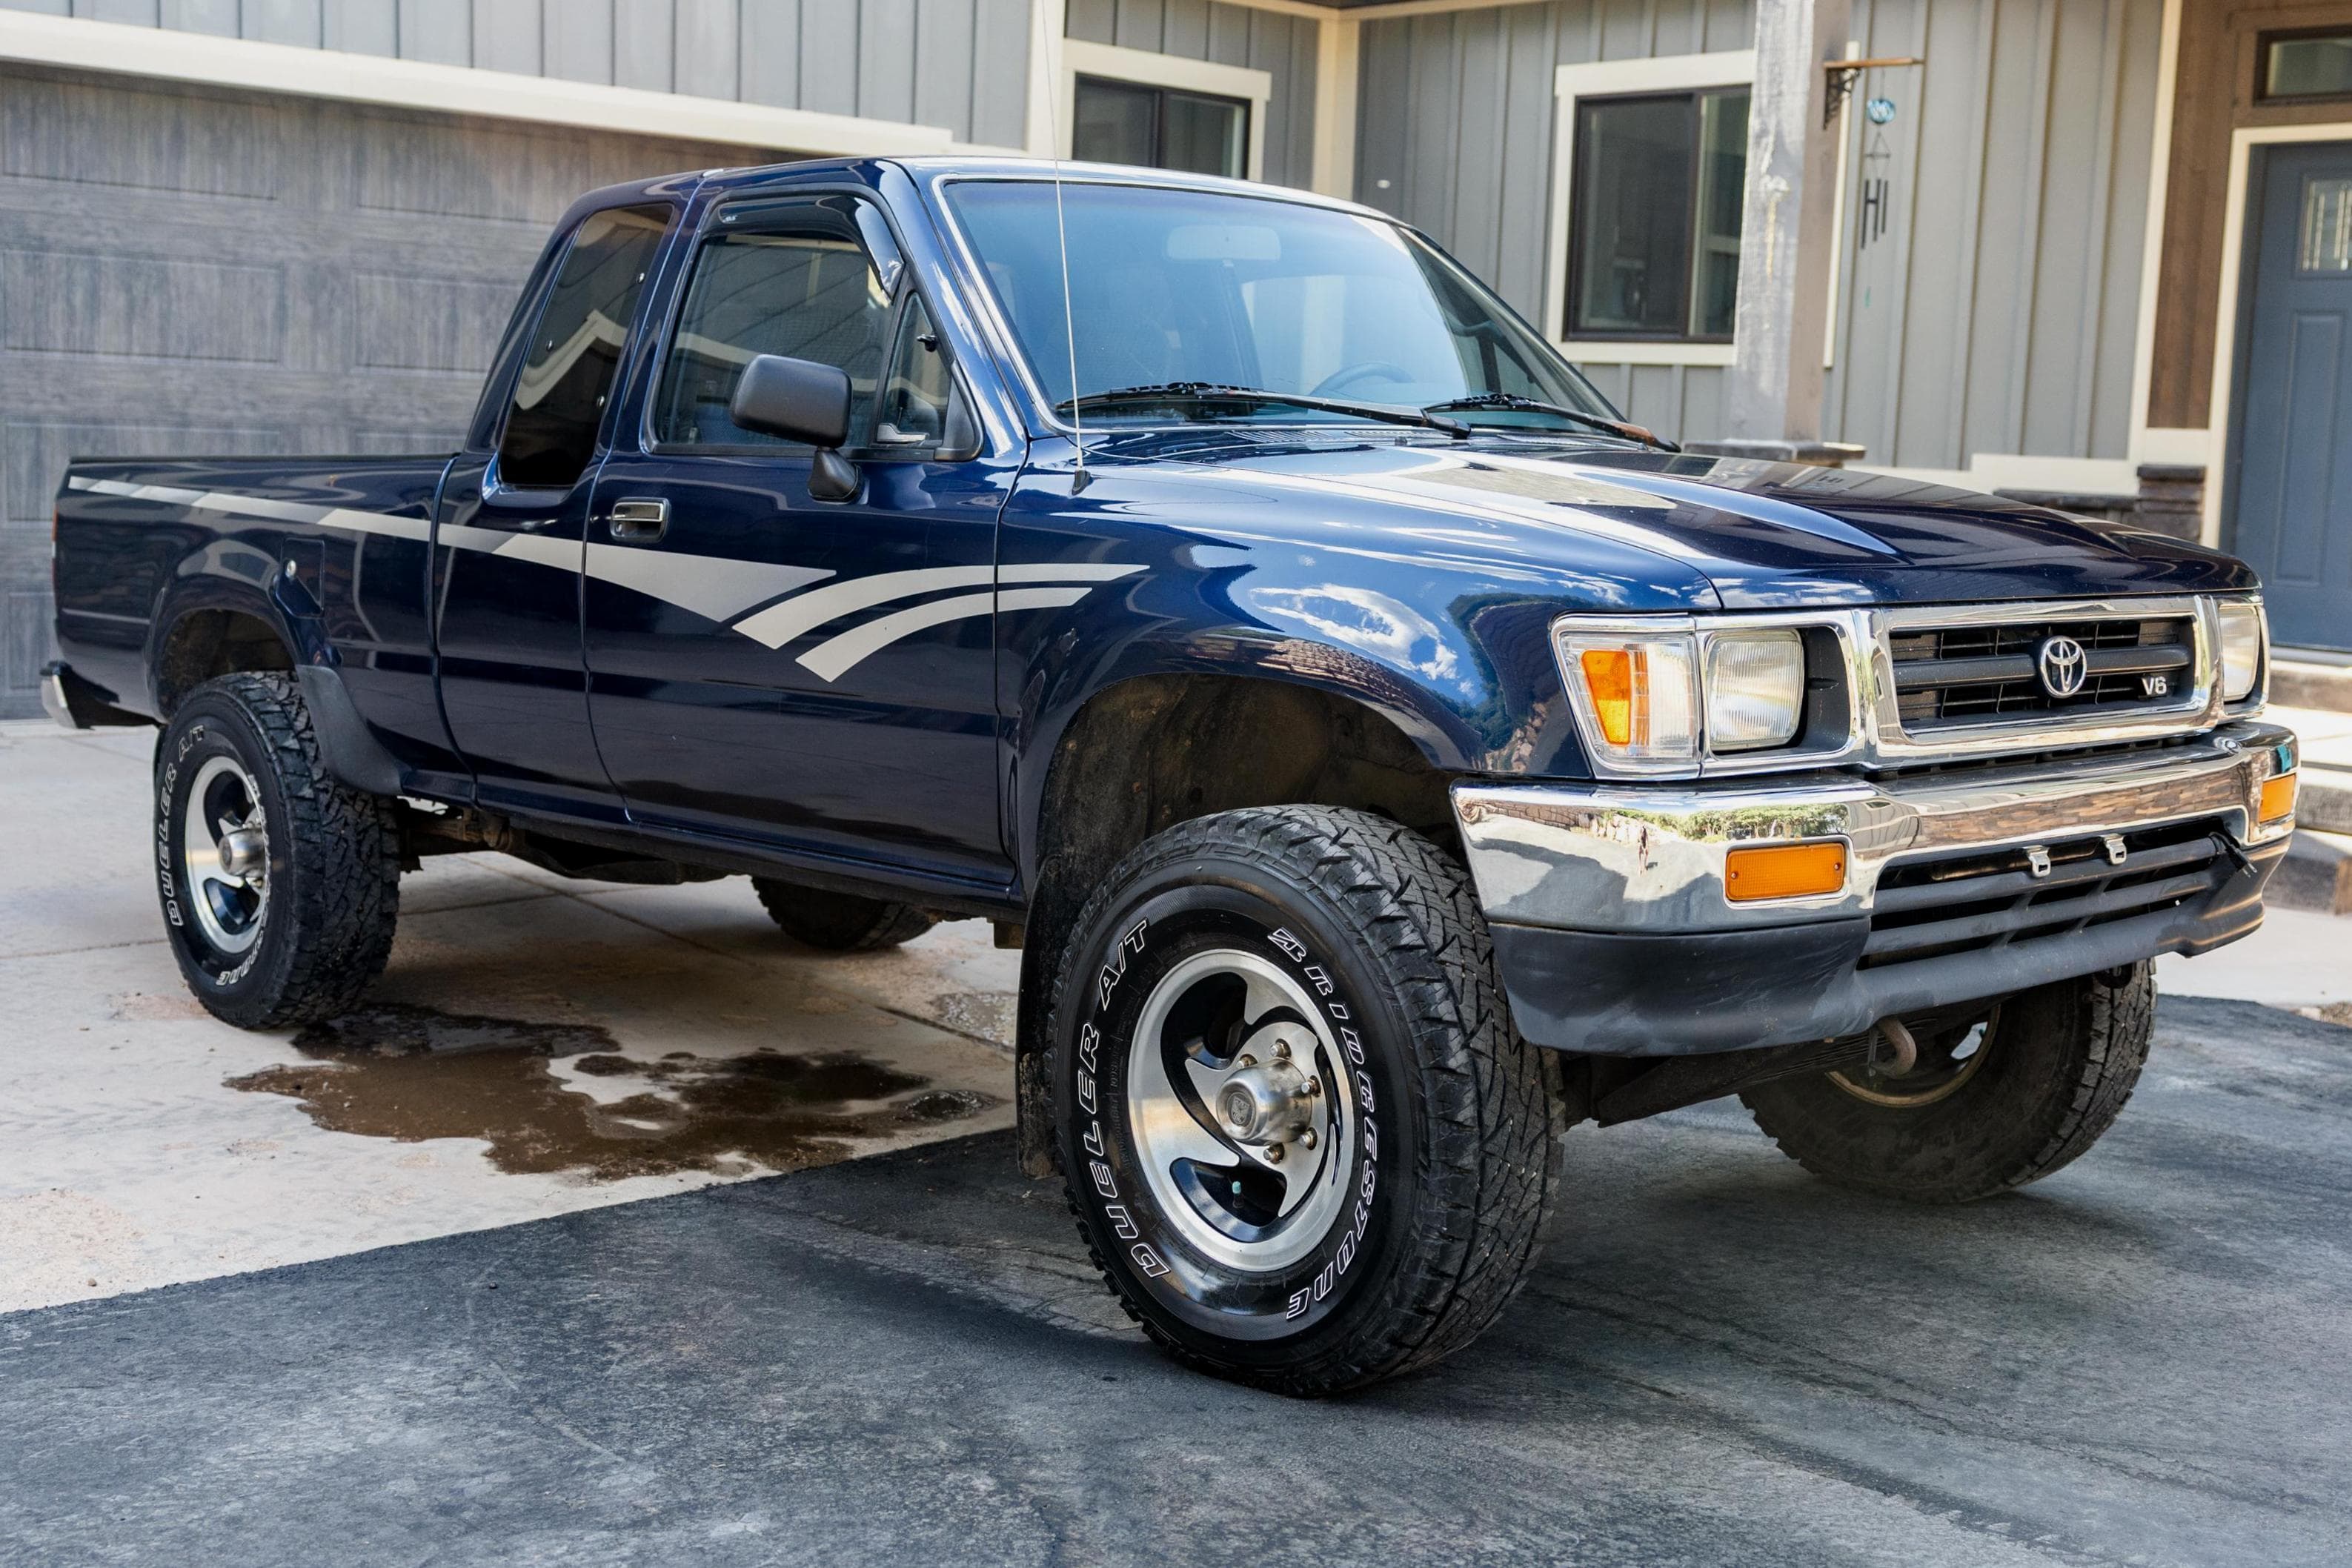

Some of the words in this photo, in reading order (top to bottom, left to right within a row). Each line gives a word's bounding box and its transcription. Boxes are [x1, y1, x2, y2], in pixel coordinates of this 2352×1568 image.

[2142, 676, 2167, 695] V6
[158, 763, 183, 926] DUELER
[178, 725, 205, 762] A/T
[1097, 919, 1149, 1011] A/T
[1077, 1021, 1172, 1280] DUELER
[1268, 926, 1380, 1321] BRIDGESTONE
